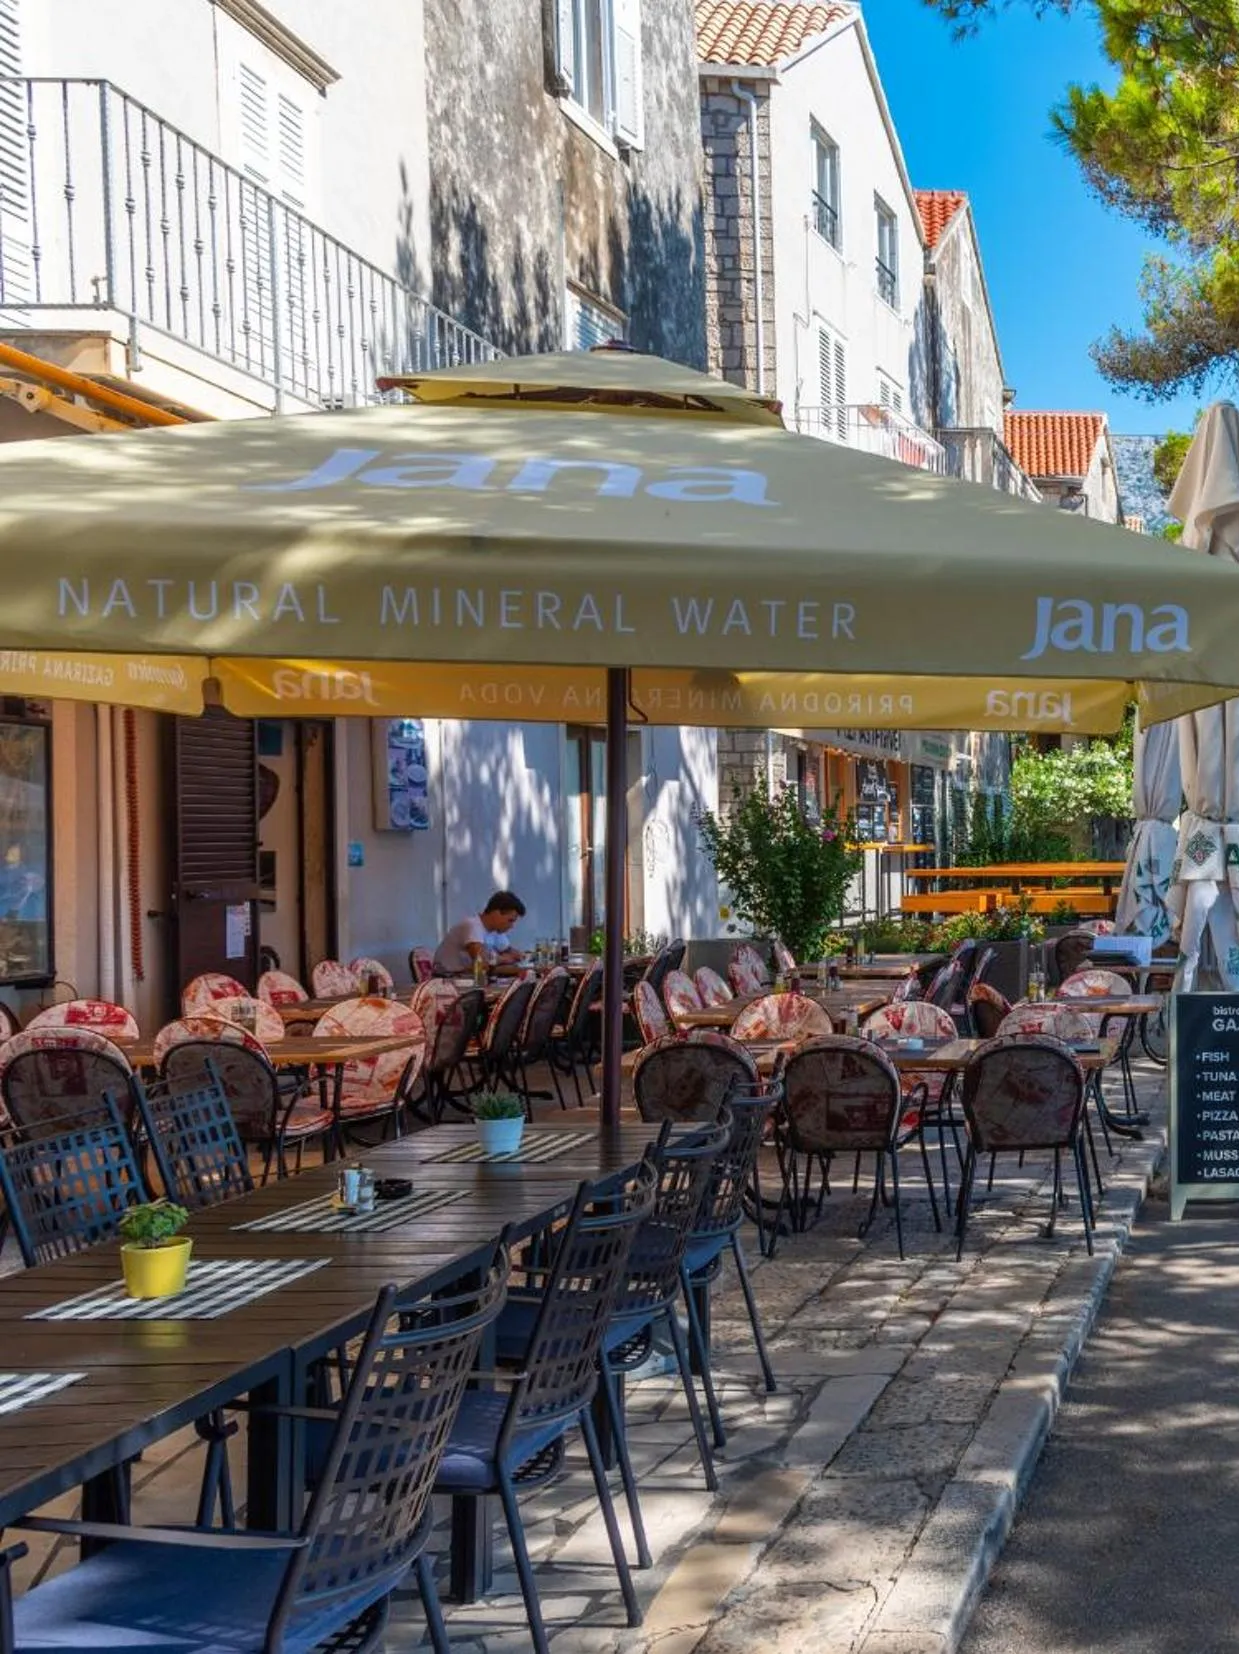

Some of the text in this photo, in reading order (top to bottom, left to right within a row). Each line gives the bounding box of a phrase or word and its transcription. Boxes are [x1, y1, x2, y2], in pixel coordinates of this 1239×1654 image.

[57, 578, 857, 639] NATURAL MINERAL WATER
[1202, 1051, 1230, 1063] FISH
[1202, 1071, 1237, 1082] TUNA
[1202, 1090, 1237, 1102] MEAT
[1202, 1110, 1239, 1122] PIZZA
